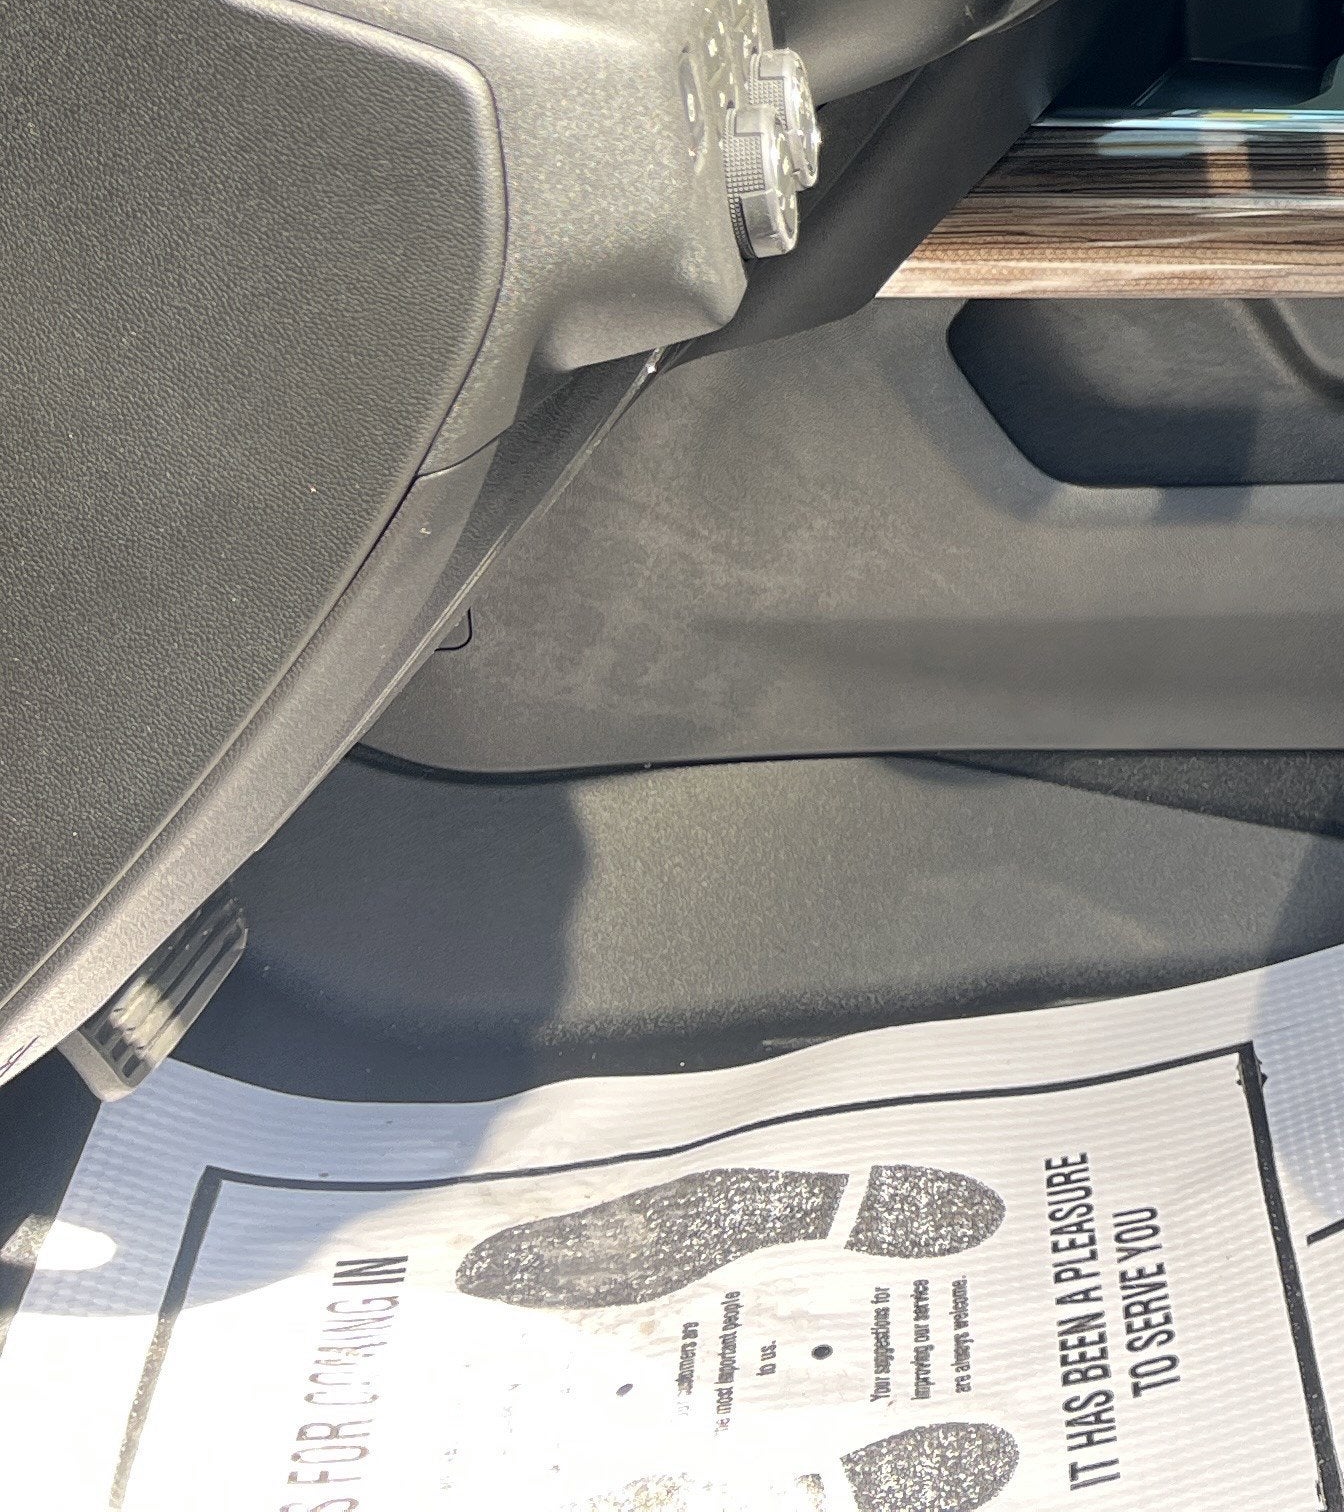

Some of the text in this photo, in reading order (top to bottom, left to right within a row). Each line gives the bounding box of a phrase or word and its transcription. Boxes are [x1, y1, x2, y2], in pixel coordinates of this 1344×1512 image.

[720, 1290, 745, 1332] people
[910, 1279, 930, 1322] service
[1044, 1152, 1121, 1491] IT HAS BEEN A PLEASURE
[1112, 1205, 1181, 1398] TO SERVE YOU
[681, 1321, 700, 1341] are
[869, 1286, 895, 1402] Your suggestions for
[913, 1323, 930, 1343] our
[949, 1331, 975, 1373] always
[286, 1419, 374, 1485] FOR
[332, 1255, 408, 1286] IN
[713, 1331, 741, 1385] important
[755, 1340, 777, 1377] to us.
[714, 1386, 734, 1415] most
[955, 1374, 972, 1393] are
